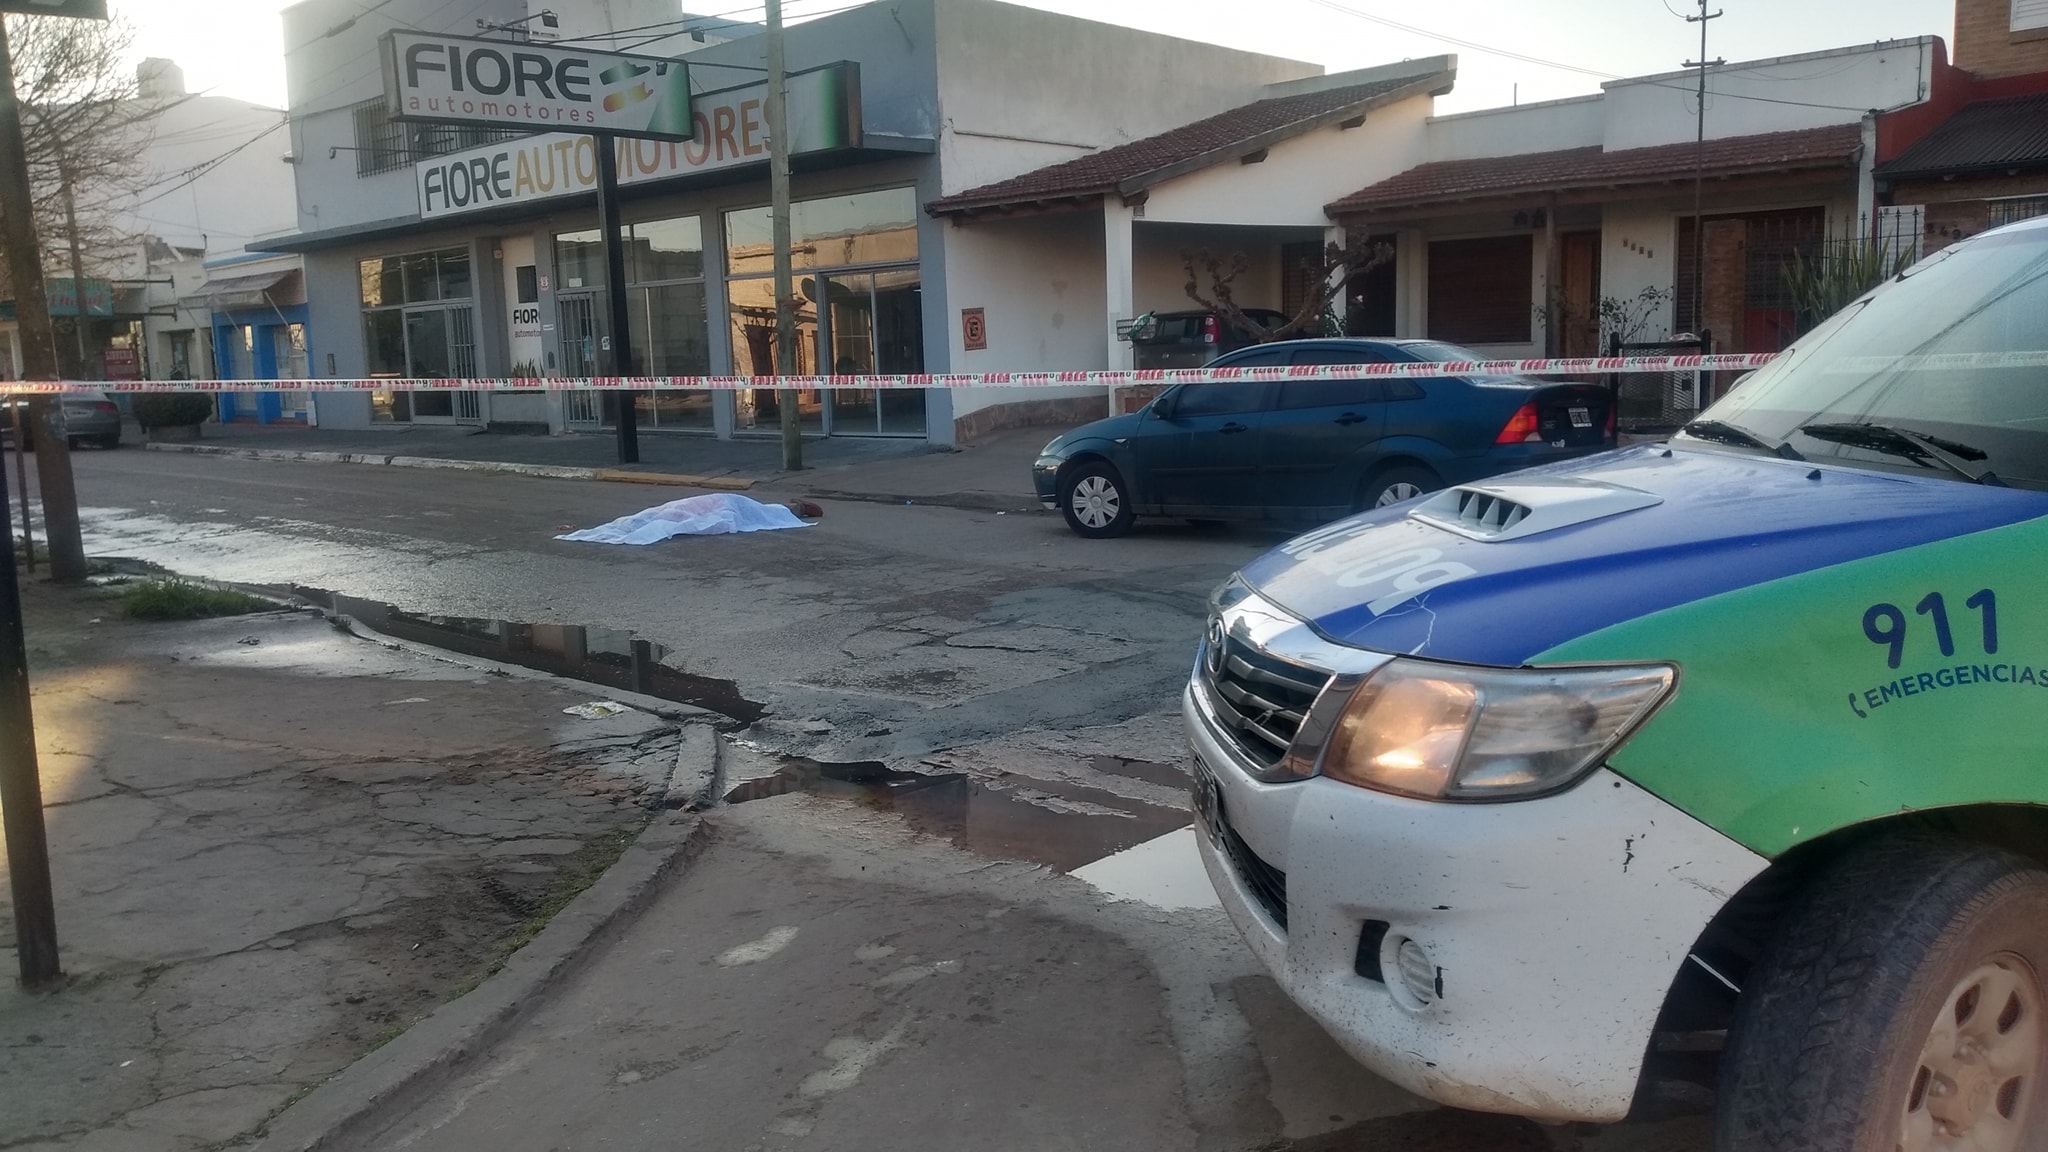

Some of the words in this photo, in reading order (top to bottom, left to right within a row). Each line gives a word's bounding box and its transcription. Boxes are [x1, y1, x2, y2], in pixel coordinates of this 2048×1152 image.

[405, 43, 592, 103] FIORE
[409, 95, 595, 123] automotores
[513, 308, 540, 325] FIOR
[1631, 357, 1671, 365] PELIGRO
[1706, 355, 1746, 363] PELIGRO
[1862, 588, 1999, 670] 911
[1863, 664, 2048, 710] EMERGENCIAS
